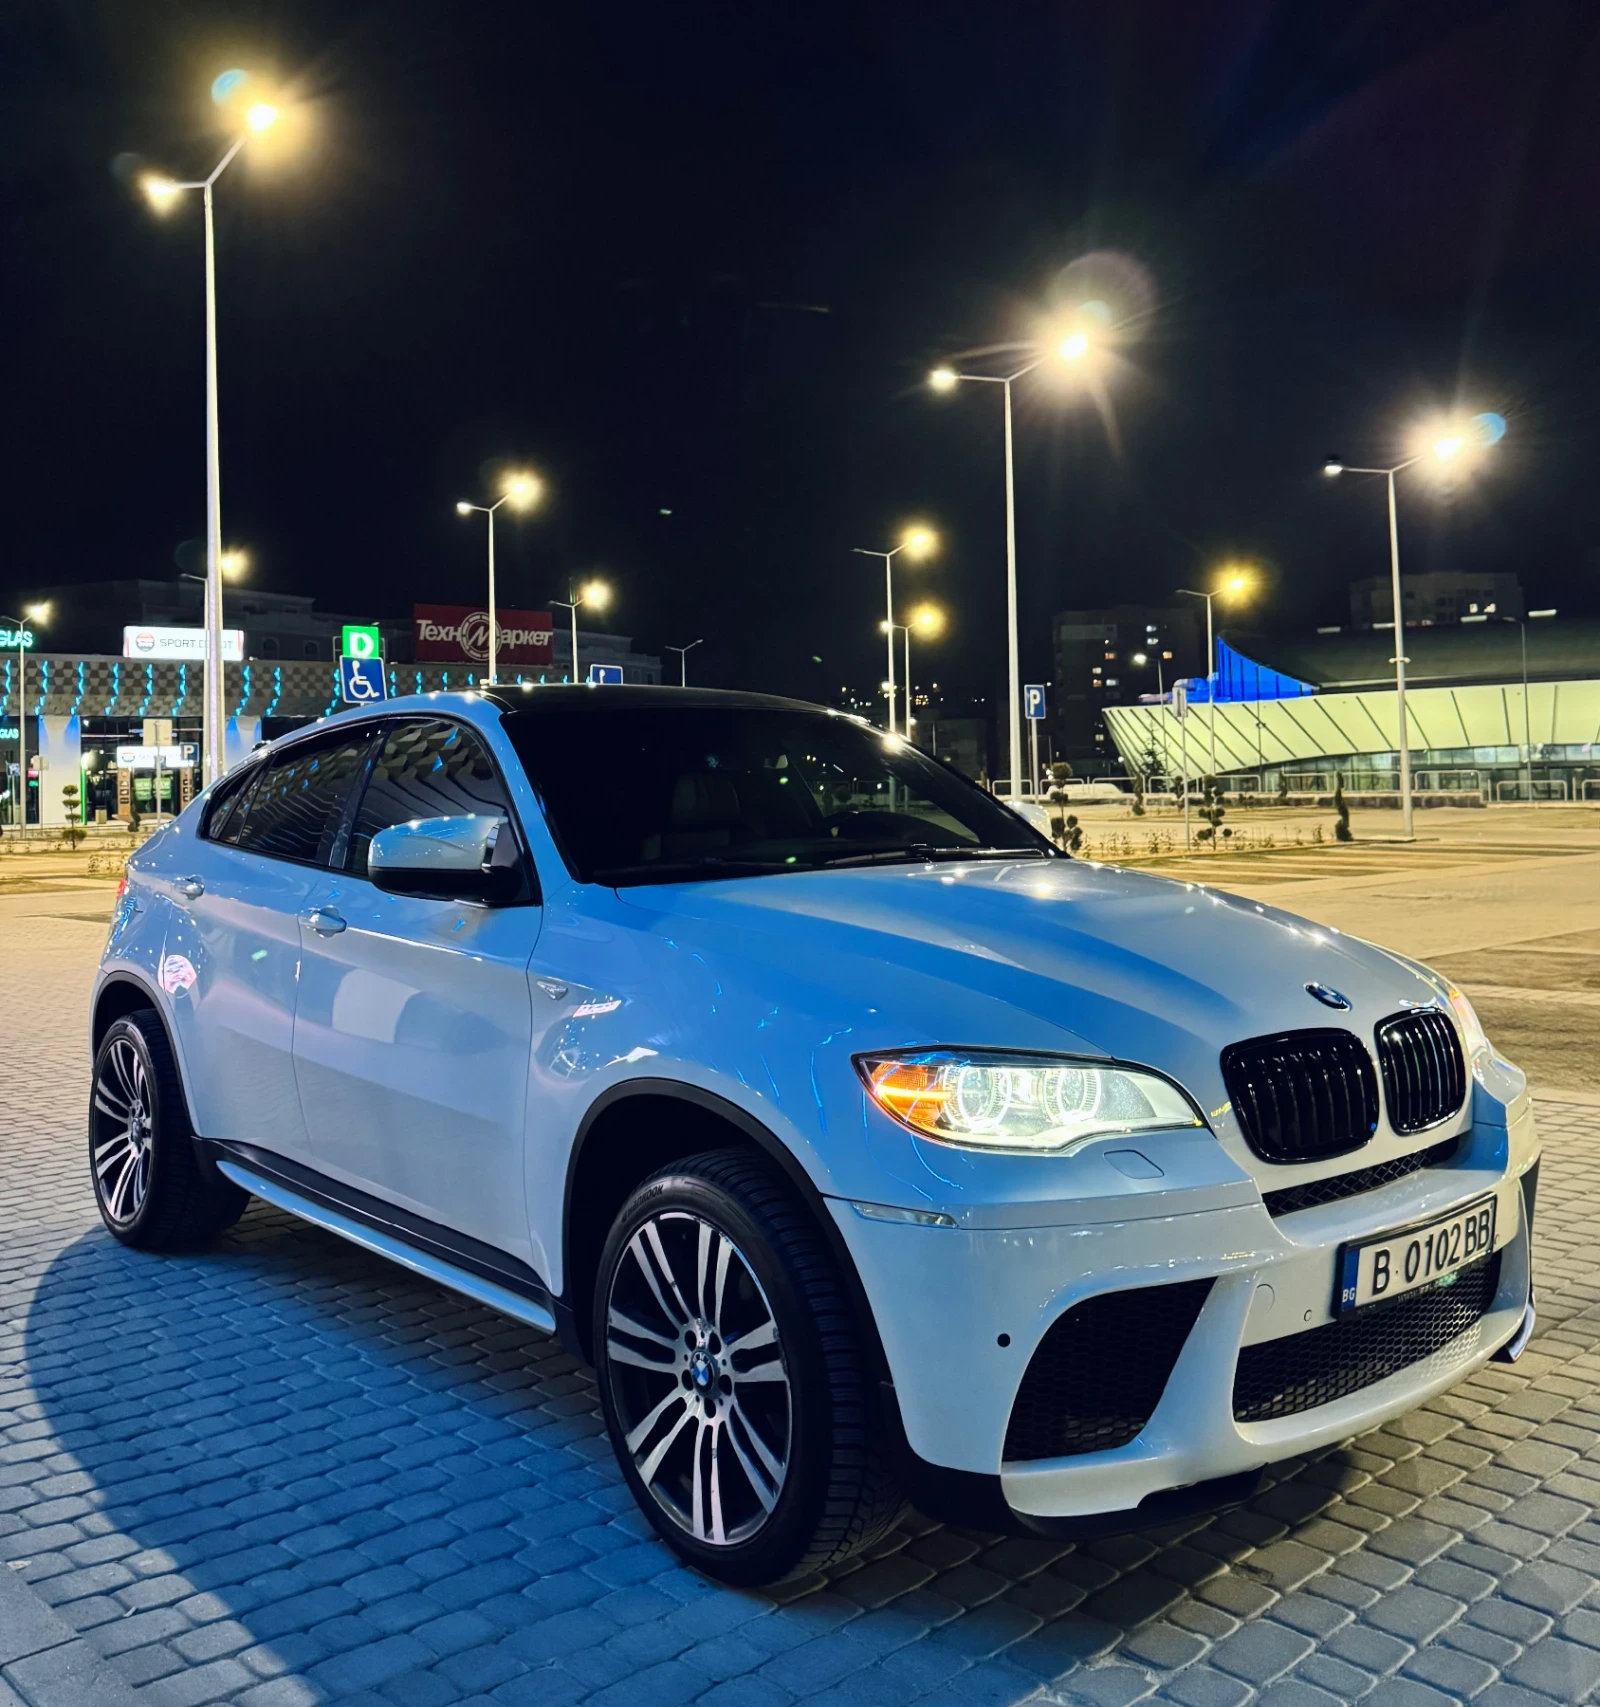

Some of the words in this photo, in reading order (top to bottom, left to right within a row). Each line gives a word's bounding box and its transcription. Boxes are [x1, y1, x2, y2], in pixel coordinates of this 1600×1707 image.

[159, 638, 196, 648] SPORT
[1029, 689, 1041, 715] P
[183, 745, 194, 760] P
[1342, 1287, 1356, 1302] BG
